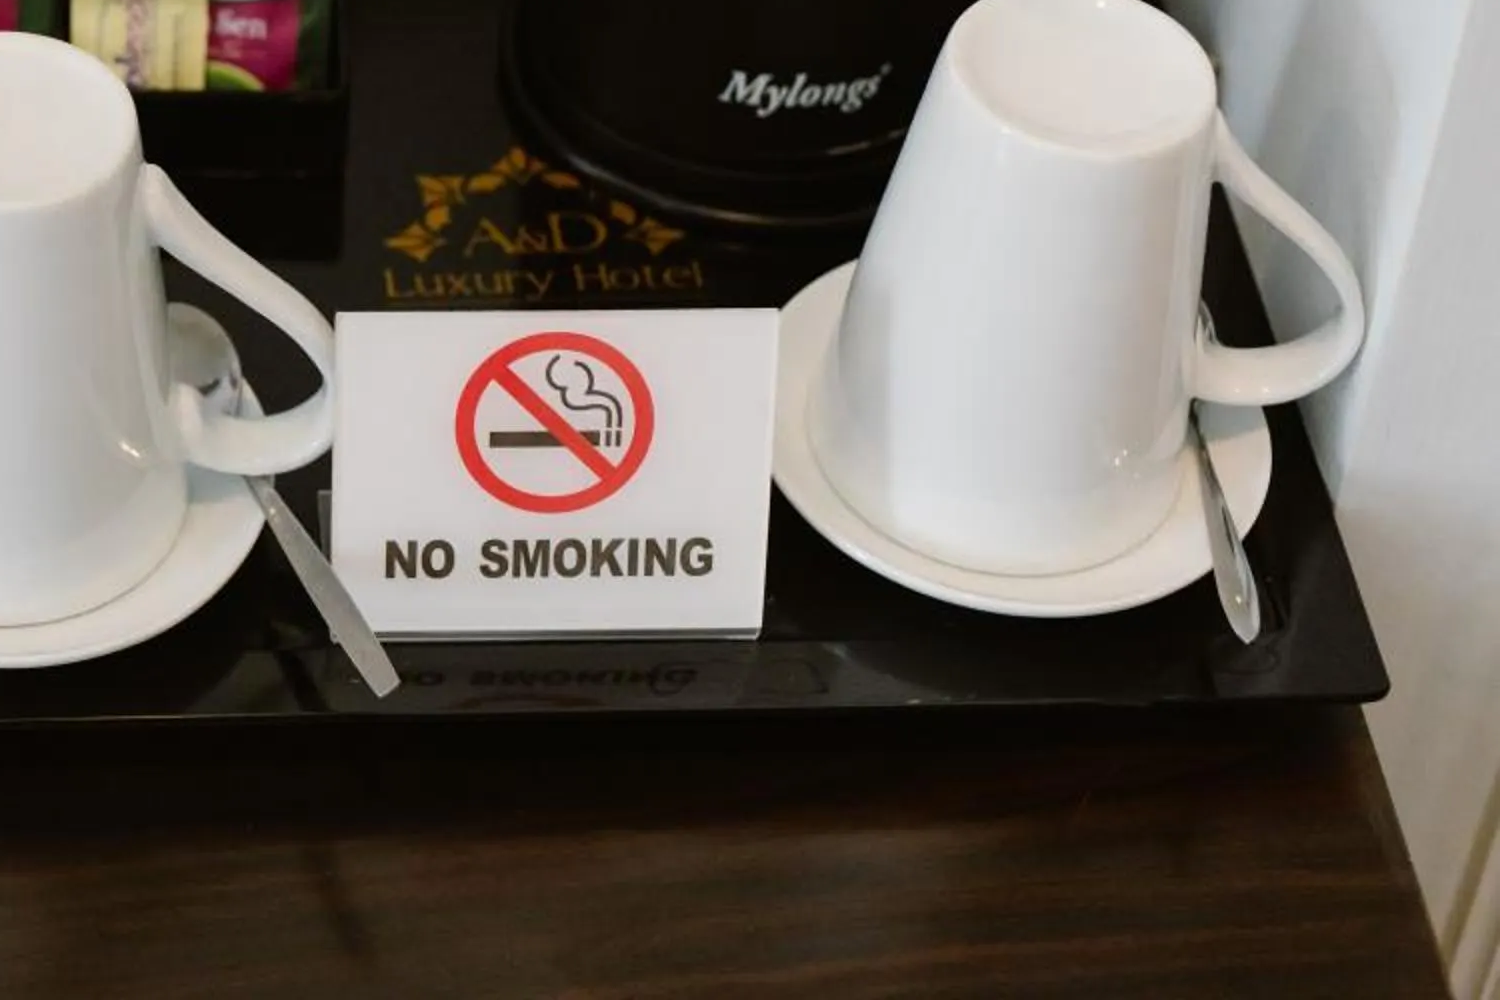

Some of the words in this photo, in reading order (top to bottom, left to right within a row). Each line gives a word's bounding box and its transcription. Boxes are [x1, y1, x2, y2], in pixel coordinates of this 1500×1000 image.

[384, 267, 553, 299] Luxury
[573, 261, 705, 292] Hotel
[384, 540, 455, 579] NO
[479, 537, 715, 577] SMOKING
